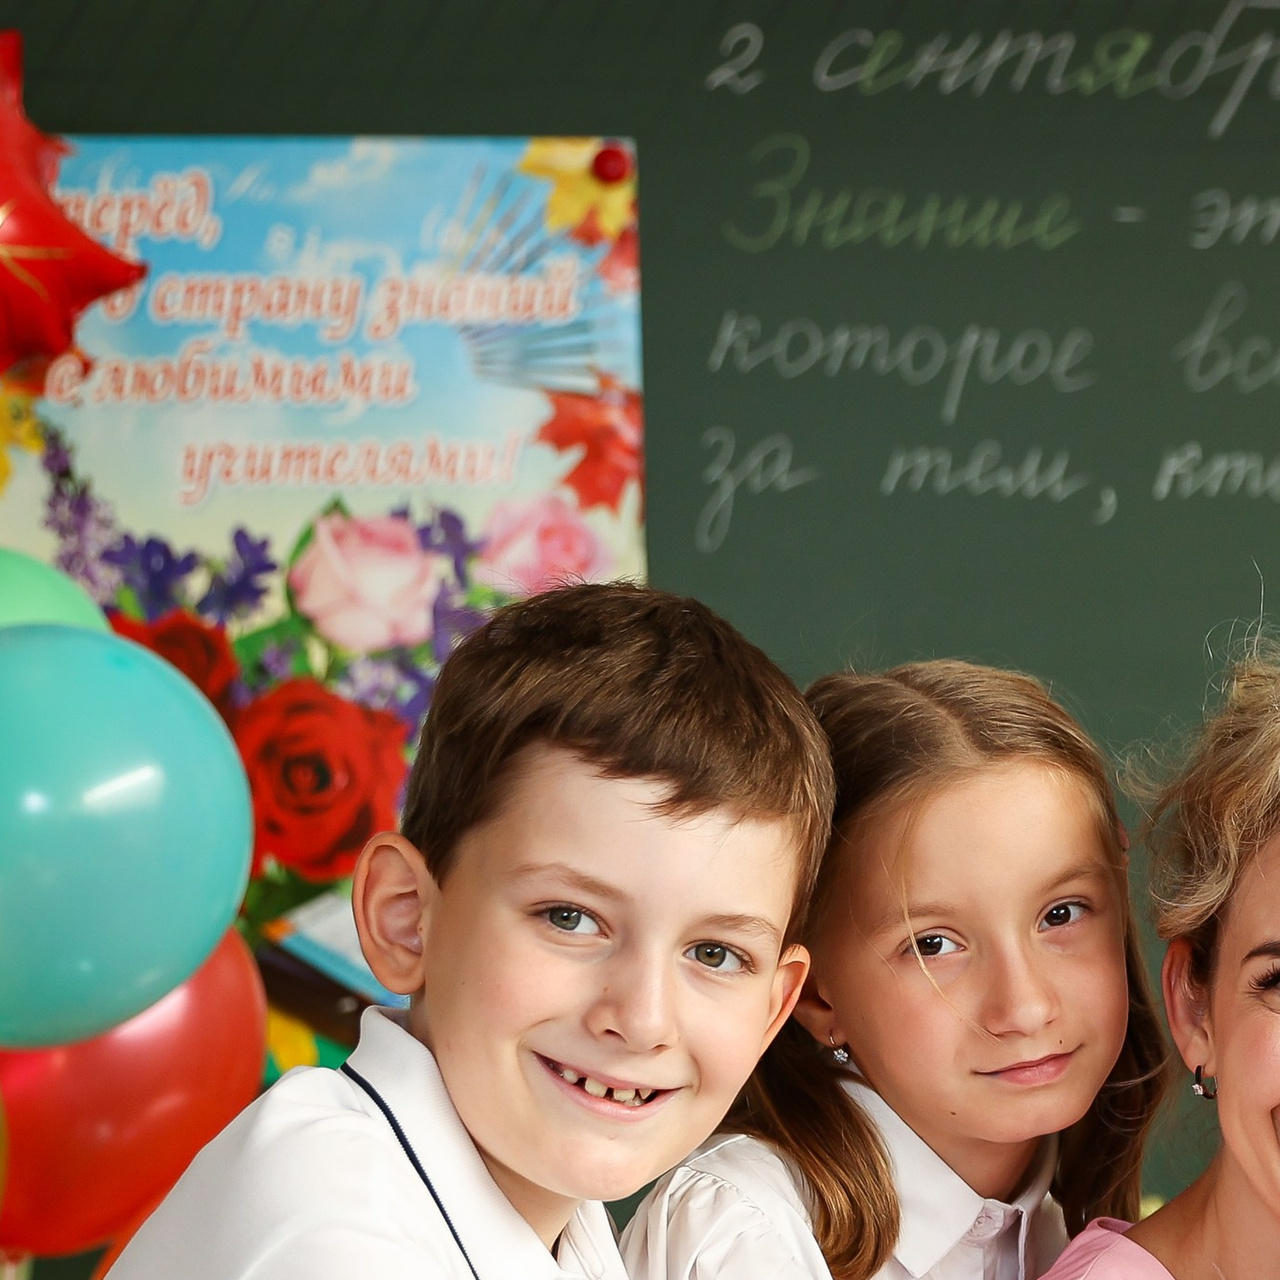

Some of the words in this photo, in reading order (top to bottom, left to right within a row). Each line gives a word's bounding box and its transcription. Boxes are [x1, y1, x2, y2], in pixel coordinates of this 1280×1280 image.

[706, 22, 765, 94] 2
[722, 133, 1084, 254] Знание
[706, 308, 1098, 425] которое
[697, 425, 822, 553] за
